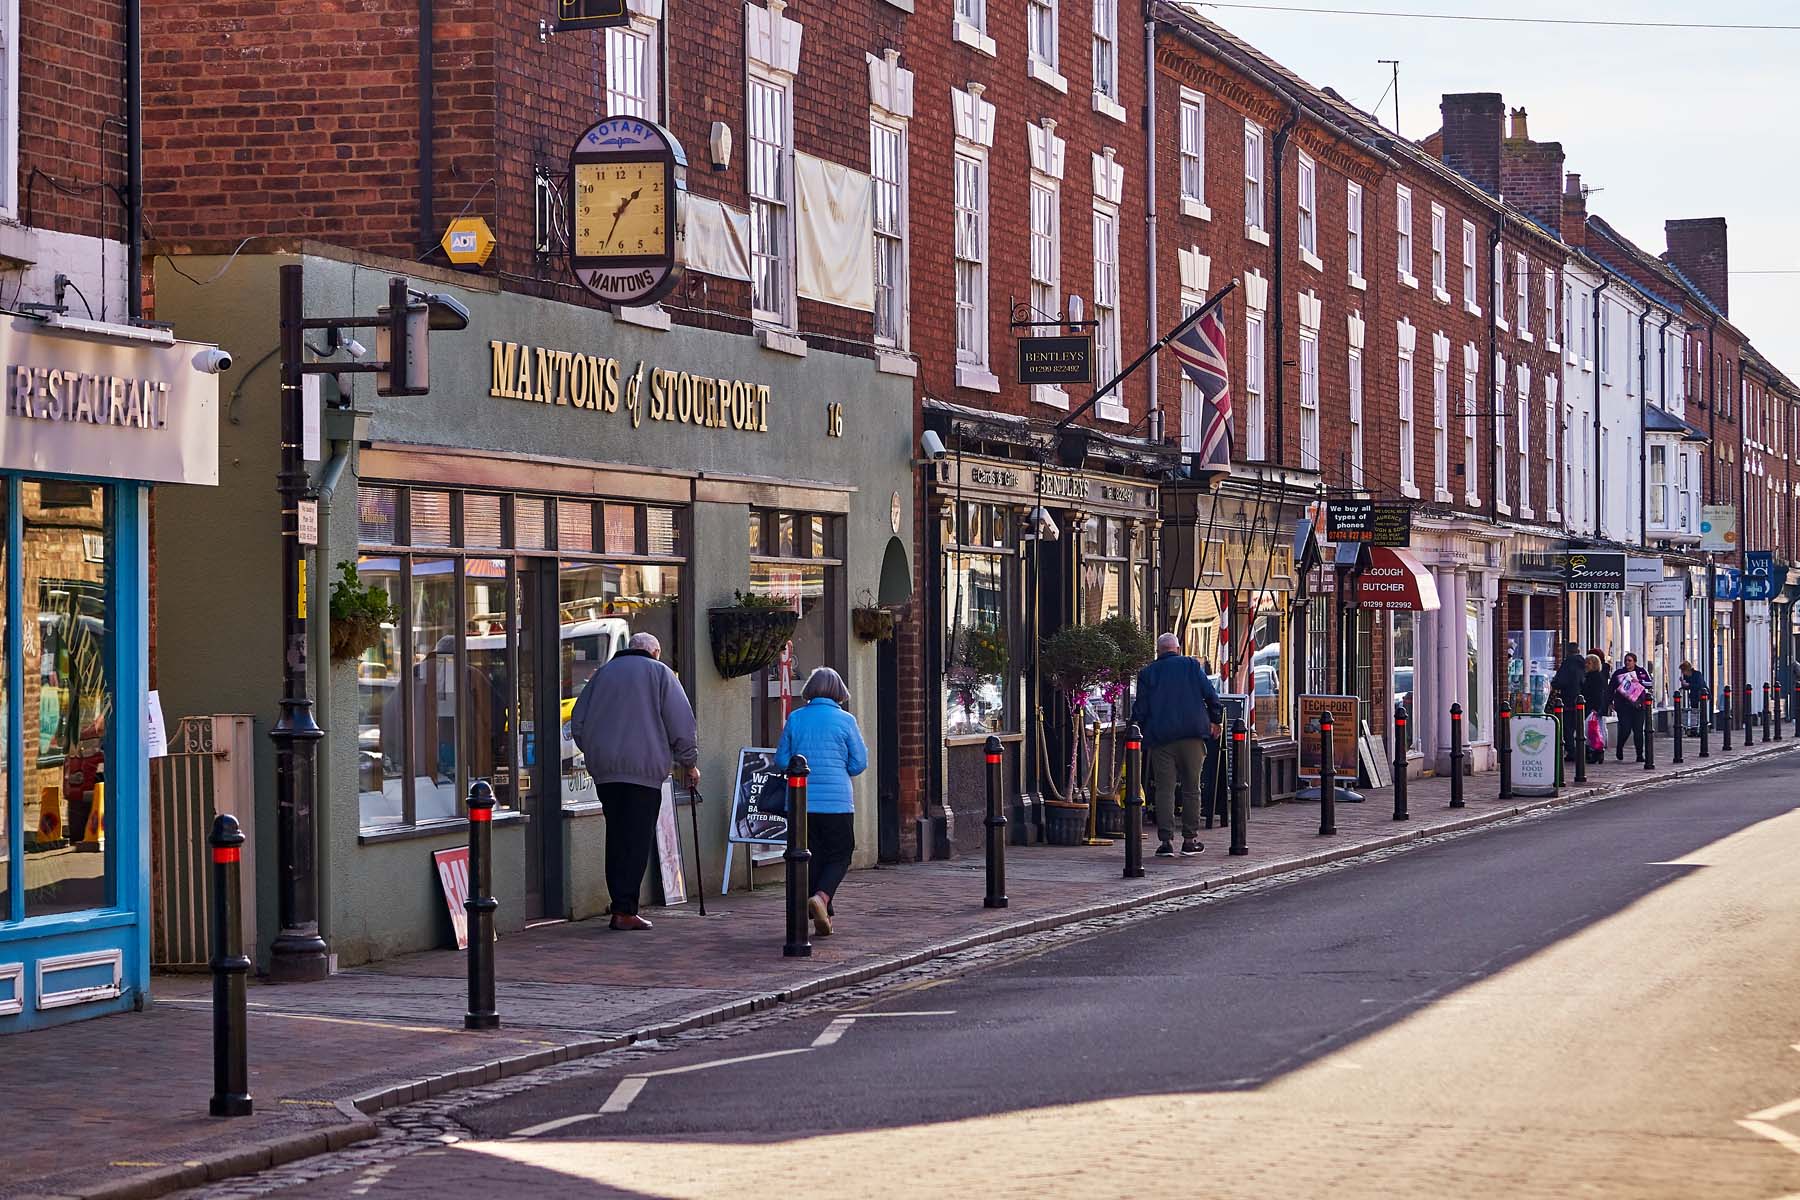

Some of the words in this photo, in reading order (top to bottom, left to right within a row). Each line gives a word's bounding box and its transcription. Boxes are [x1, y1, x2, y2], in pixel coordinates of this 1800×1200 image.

[587, 121, 654, 145] ROTARY
[596, 171, 605, 181] 11
[615, 170, 626, 180] 12
[583, 184, 594, 194] 10
[653, 183, 659, 191] 2
[584, 206, 590, 215] 9
[653, 205, 659, 214] 3
[584, 228, 590, 237] 8
[653, 227, 659, 235] 4
[453, 235, 476, 248] ADT
[599, 241, 605, 250] 7
[618, 240, 624, 249] 6
[638, 240, 643, 249] 5
[588, 269, 655, 293] MANTONS
[1025, 351, 1084, 362] BENTLEYS
[490, 340, 620, 413] MANTONS
[651, 366, 771, 432] STOURPORT
[11, 365, 172, 431] RESTAURANT
[828, 401, 843, 437] 16
[976, 467, 996, 484] Cards
[997, 471, 1003, 485] &
[1040, 473, 1089, 498] BENTLEYS
[1344, 505, 1359, 513] buy
[1751, 559, 1768, 567] WH
[1371, 568, 1404, 576] GOUGH
[1571, 564, 1621, 578] Severn
[1362, 583, 1405, 591] BUTCHER
[1386, 601, 1412, 609] 822992
[1304, 700, 1353, 712] TECH-PORT
[749, 795, 756, 804] &
